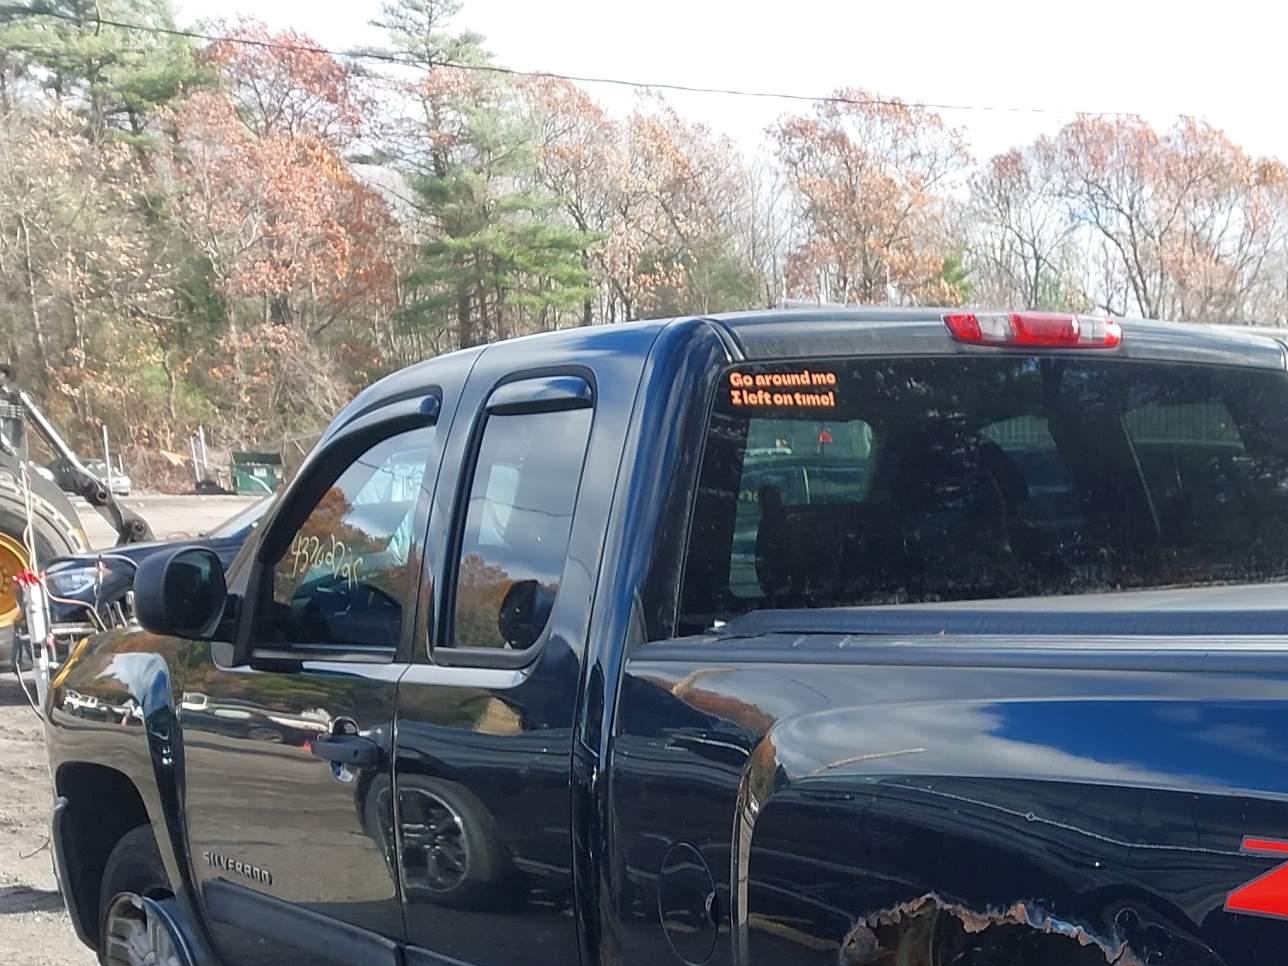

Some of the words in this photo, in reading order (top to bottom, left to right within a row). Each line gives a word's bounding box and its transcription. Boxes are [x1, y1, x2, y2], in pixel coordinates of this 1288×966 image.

[730, 372, 753, 387] Go
[755, 370, 810, 386] around
[730, 389, 742, 405] I
[743, 390, 771, 405] left
[773, 393, 793, 406] on
[203, 851, 272, 885] SILVERADO
